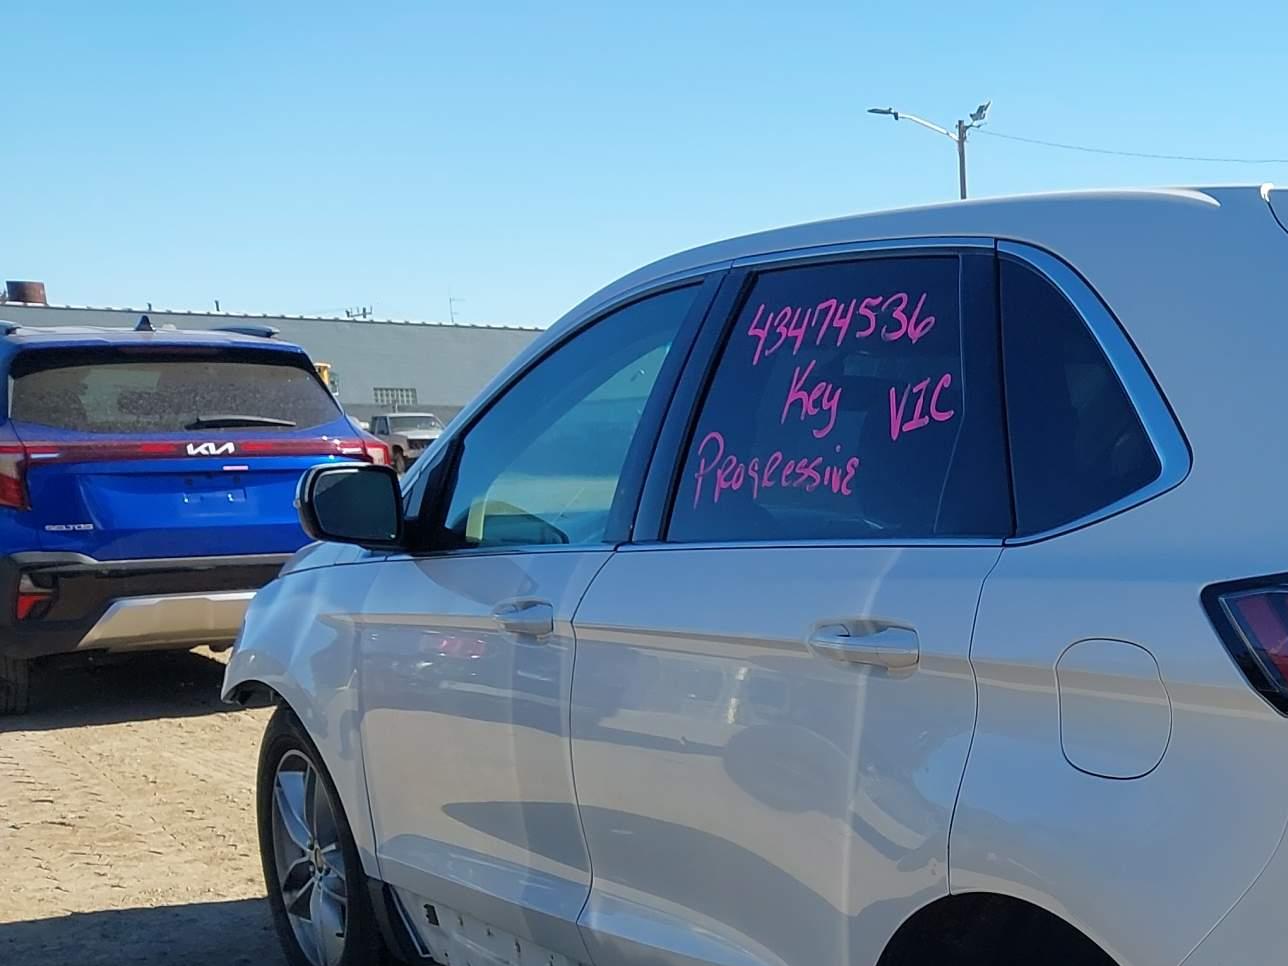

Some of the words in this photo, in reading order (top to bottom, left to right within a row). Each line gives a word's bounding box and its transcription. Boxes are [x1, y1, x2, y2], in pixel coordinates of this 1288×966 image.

[747, 292, 937, 366] 43474536
[780, 359, 843, 438] Key
[889, 373, 955, 441] VIC
[186, 441, 236, 456] KIA
